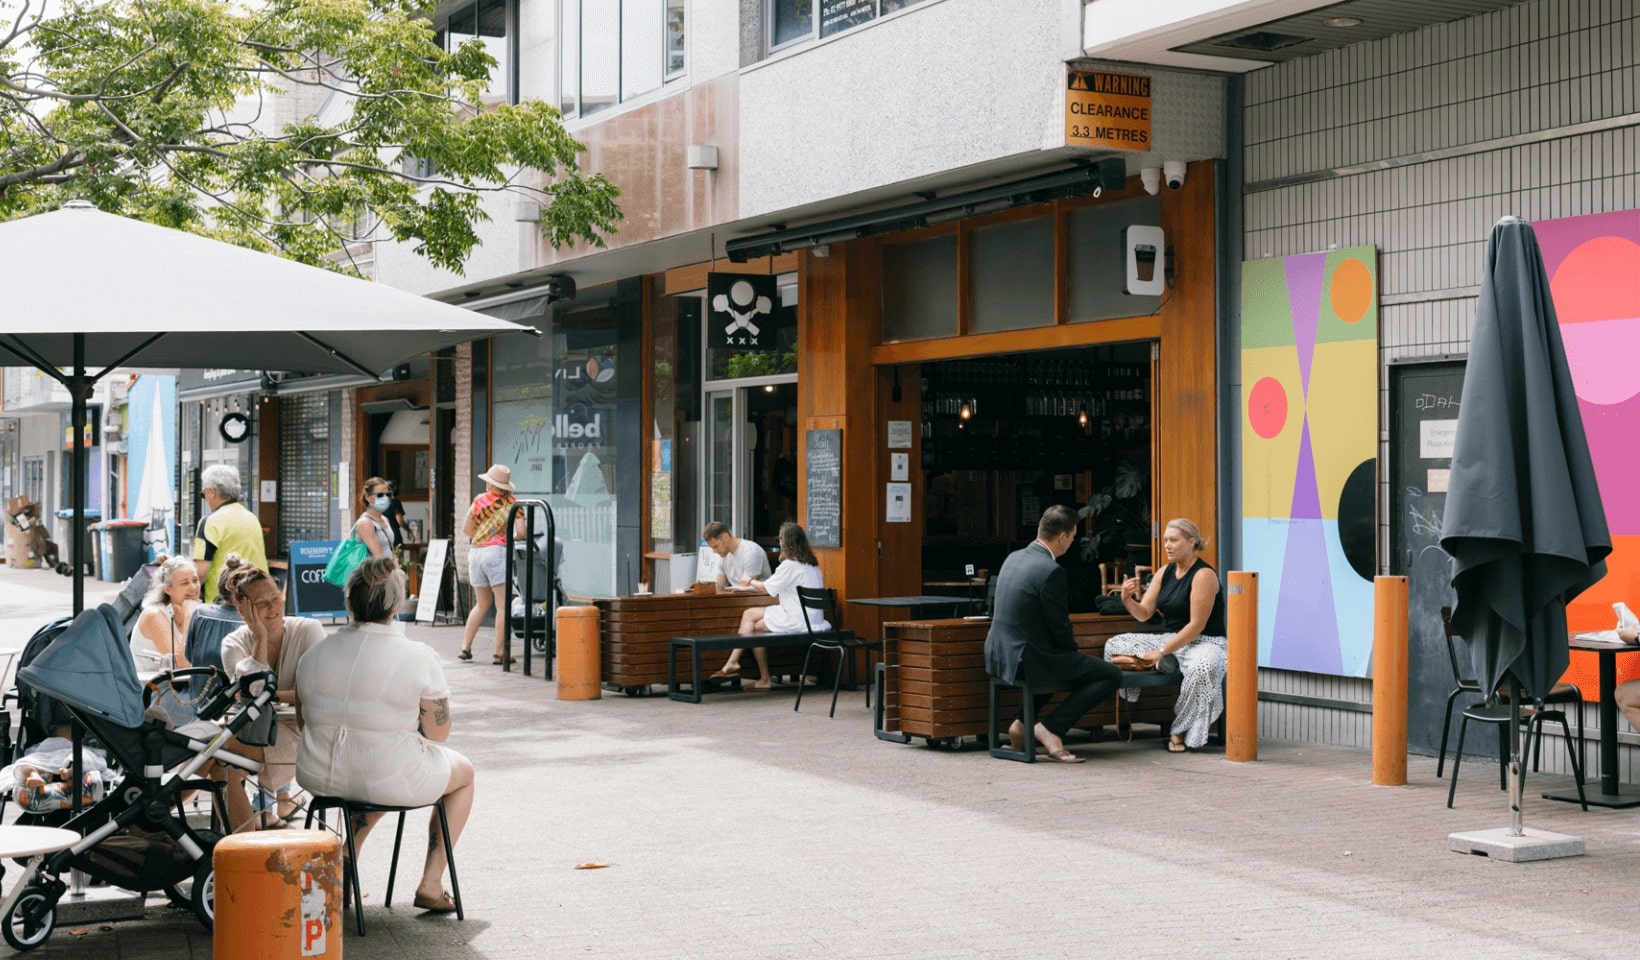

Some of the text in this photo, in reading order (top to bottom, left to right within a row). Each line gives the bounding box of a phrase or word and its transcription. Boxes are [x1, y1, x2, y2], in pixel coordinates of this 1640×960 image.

[1094, 72, 1148, 96] WARNING
[1070, 101, 1149, 121] CLEARANCE
[1071, 125, 1148, 143] 3.3 METRES
